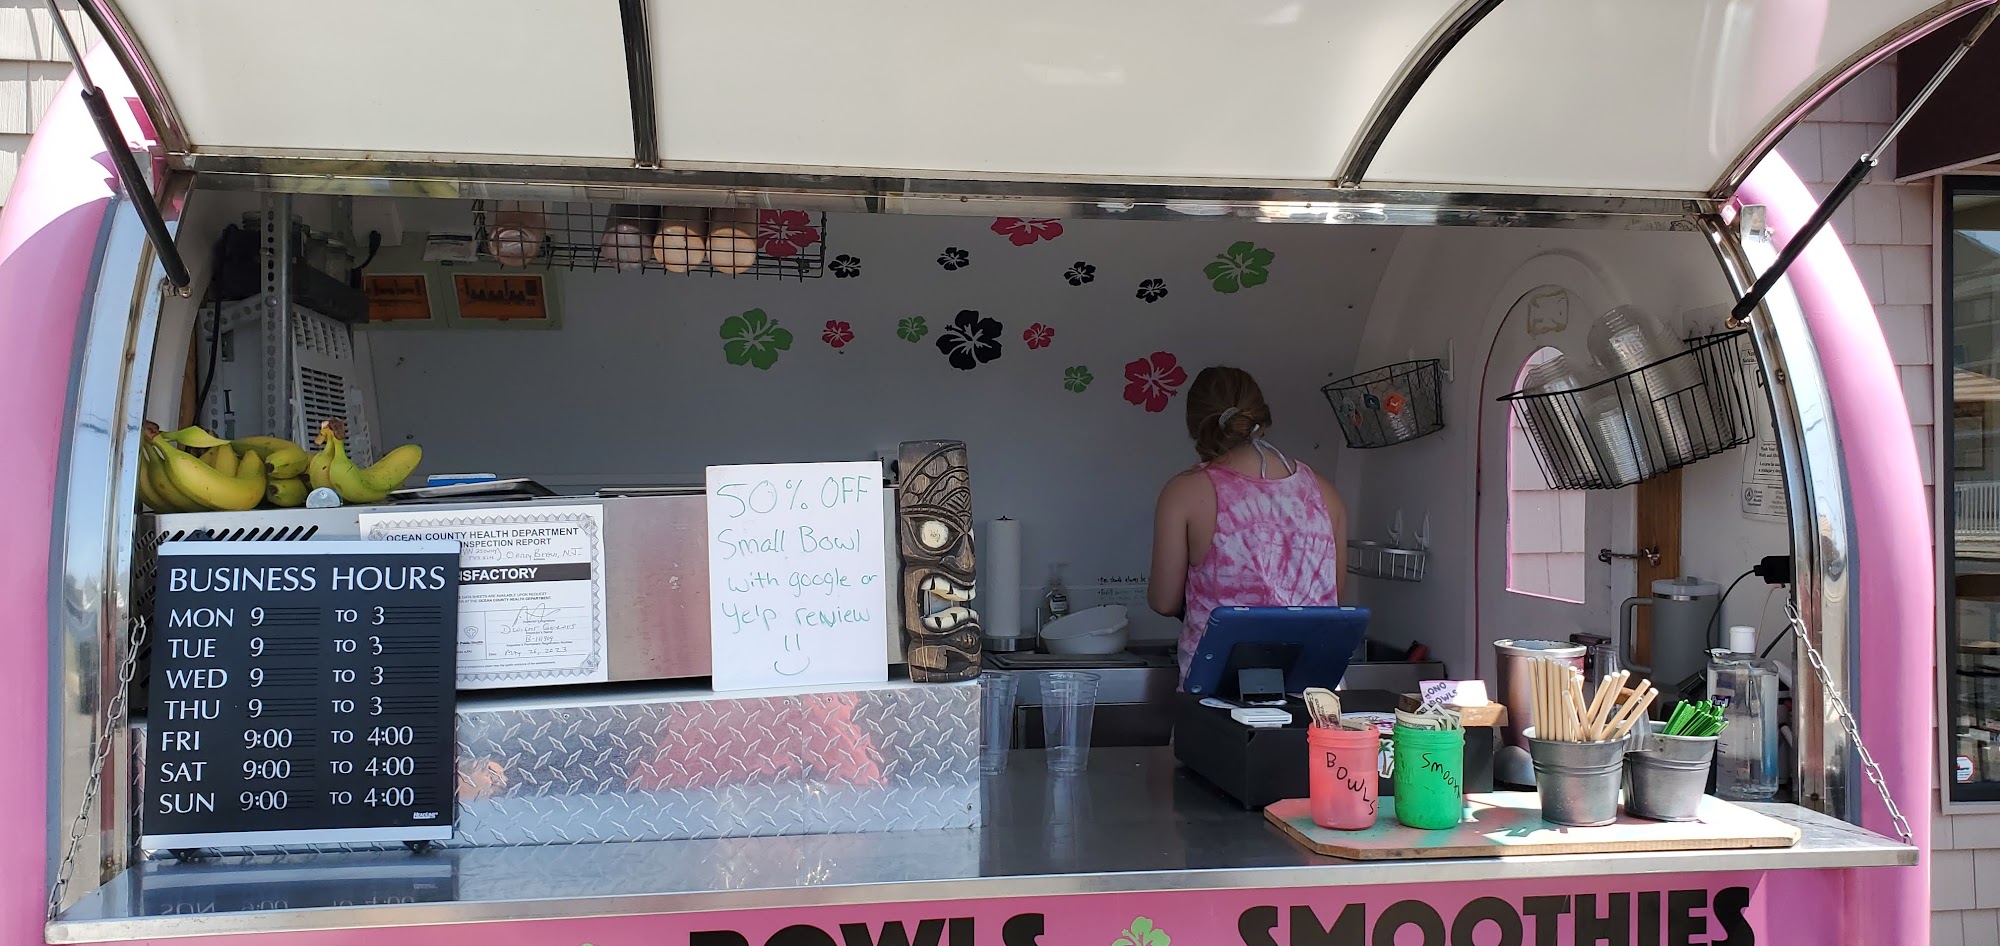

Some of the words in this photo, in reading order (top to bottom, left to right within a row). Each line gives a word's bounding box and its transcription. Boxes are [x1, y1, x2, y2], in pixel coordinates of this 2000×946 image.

[820, 475, 872, 509] OFF
[386, 533, 422, 542] OCEAN
[425, 531, 467, 541] COUNTY
[470, 529, 509, 539] HEALTH
[512, 527, 579, 538] DEPARTMENT
[516, 538, 552, 547] REPORT
[717, 528, 786, 560] Small
[799, 525, 861, 554] Bowl
[169, 566, 317, 592] BUSINESS
[331, 565, 446, 592] HOURS
[728, 571, 779, 593] with
[788, 567, 852, 598] google
[860, 574, 879, 586] or
[168, 608, 235, 629] MON
[250, 606, 265, 628] 9
[334, 609, 358, 623] TO
[371, 605, 385, 626] 3
[168, 638, 217, 659] TUE
[250, 636, 264, 658] 9
[333, 639, 357, 653] TO
[368, 635, 383, 656] 3
[166, 669, 228, 690] WED
[249, 667, 264, 688] 9
[332, 669, 356, 683] TO
[370, 666, 384, 686] 3
[164, 699, 220, 720] THU
[248, 698, 263, 718] 9
[331, 699, 355, 713] TO
[369, 696, 383, 716] 3
[162, 731, 200, 752] FRI
[243, 728, 293, 750] 9:00
[330, 729, 354, 744] TO
[366, 725, 414, 747] 4:00
[160, 761, 208, 783] SAT
[242, 758, 291, 781] 9:00
[329, 760, 353, 774] TO
[364, 756, 415, 777] 4:00
[1326, 752, 1376, 816] BOWLS
[159, 792, 215, 815] SUN
[239, 789, 288, 811] 9:00
[329, 791, 353, 805] TO
[363, 786, 415, 807] 4:00
